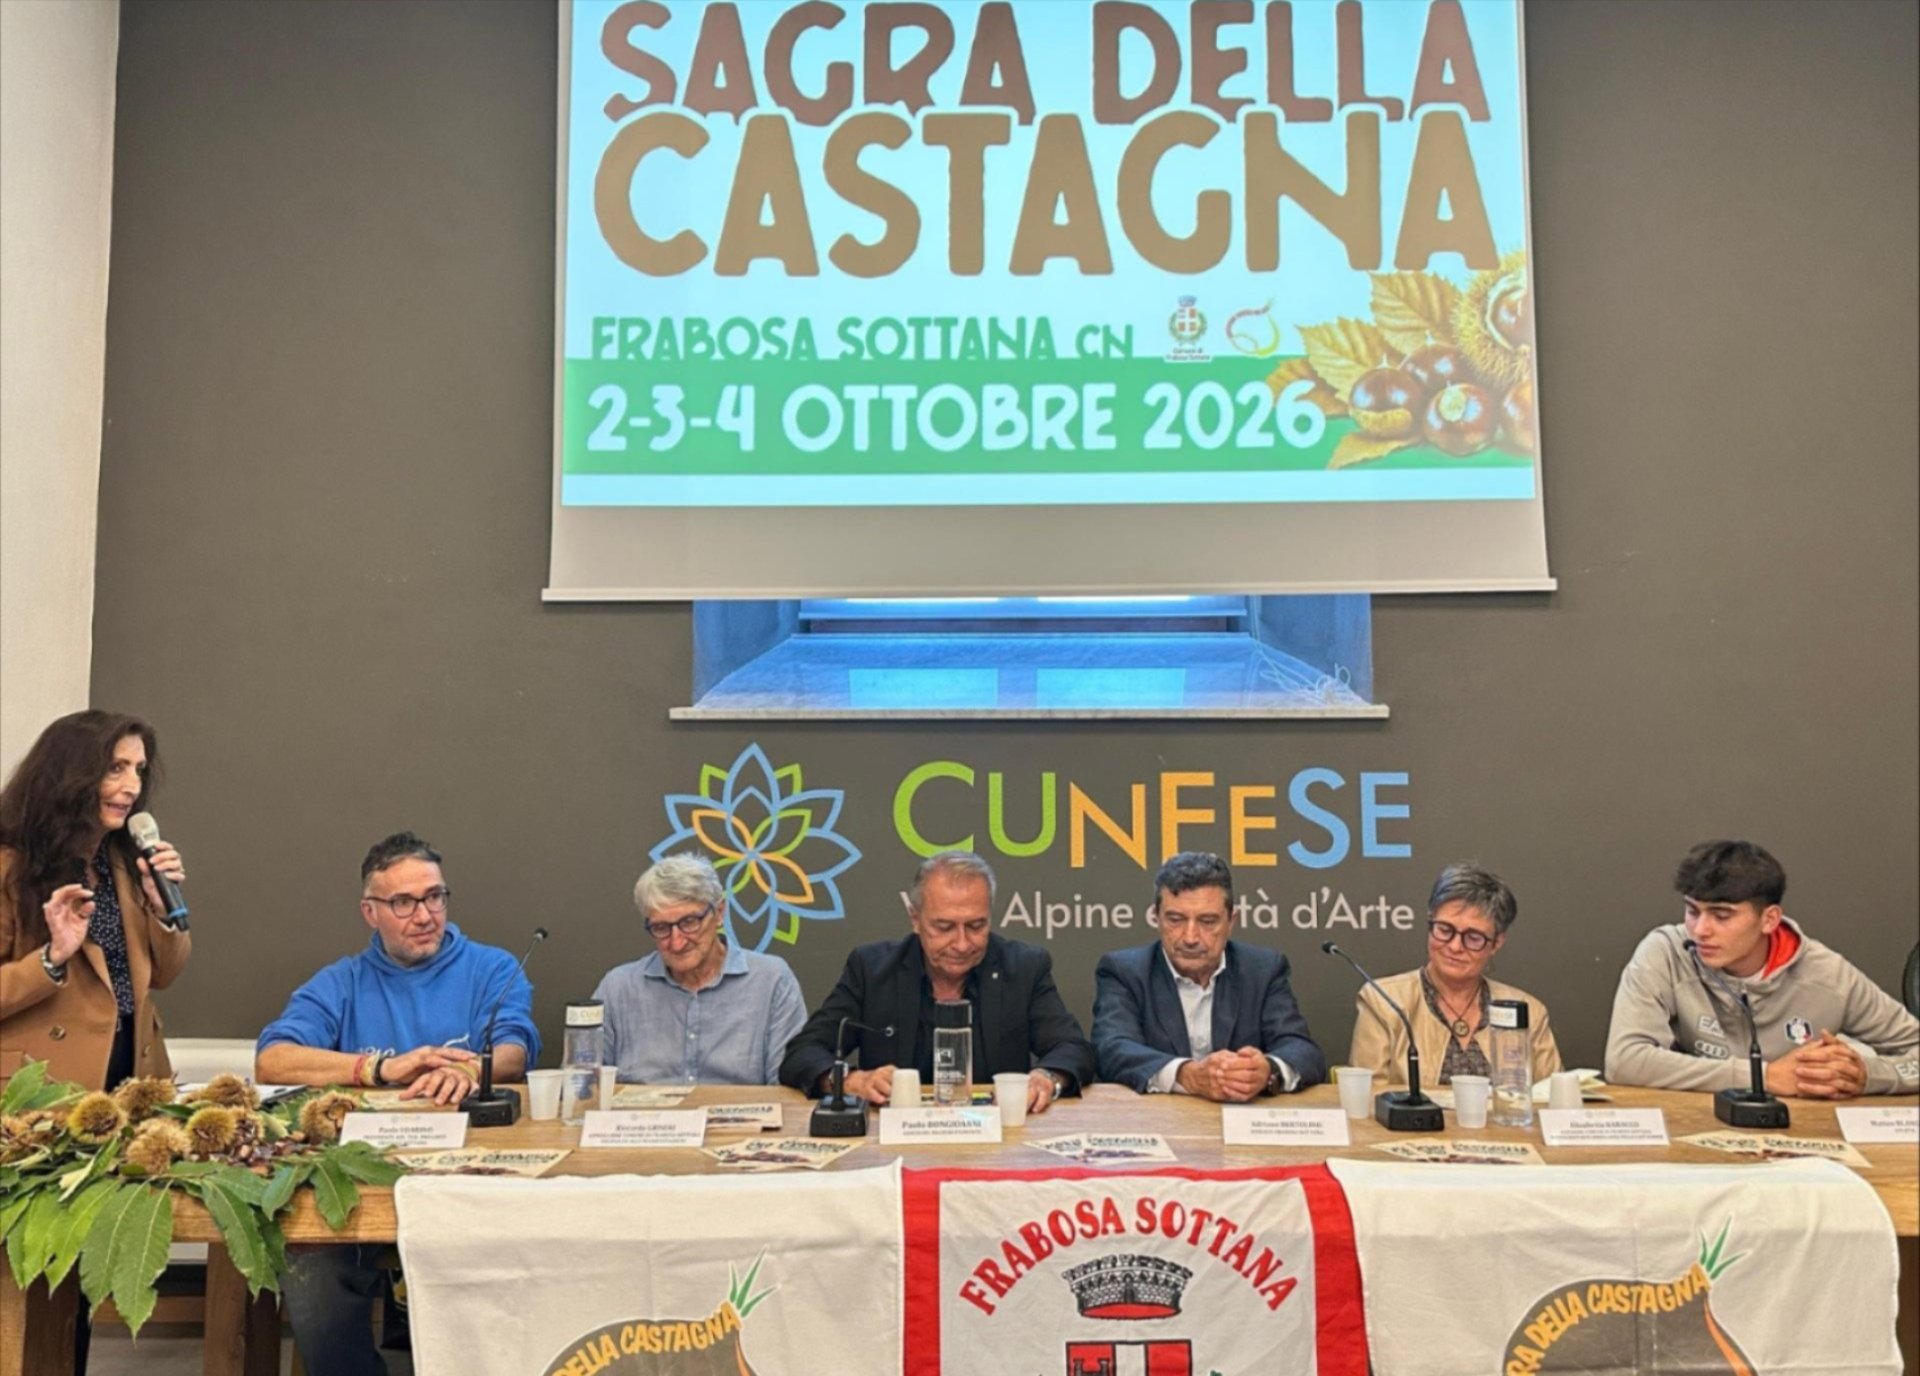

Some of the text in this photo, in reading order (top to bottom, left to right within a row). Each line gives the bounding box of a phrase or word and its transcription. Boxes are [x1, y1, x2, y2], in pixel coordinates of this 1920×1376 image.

[601, 0, 1491, 126] SAGRA DELLA
[594, 110, 1500, 278] CASTAGNA
[592, 316, 1133, 360] FRABOSA SOTTANA CN
[587, 380, 1326, 452] 2-3-4 OTTOBRE 2026
[1000, 890, 1134, 939] Alpine
[1292, 886, 1415, 930] d'Arte
[959, 1197, 1298, 1316] FRABOSA SOTTANA
[619, 1300, 742, 1355] CASTAGNA
[1523, 1290, 1589, 1350] DELLA
[1586, 1262, 1711, 1315] CASTAGNA
